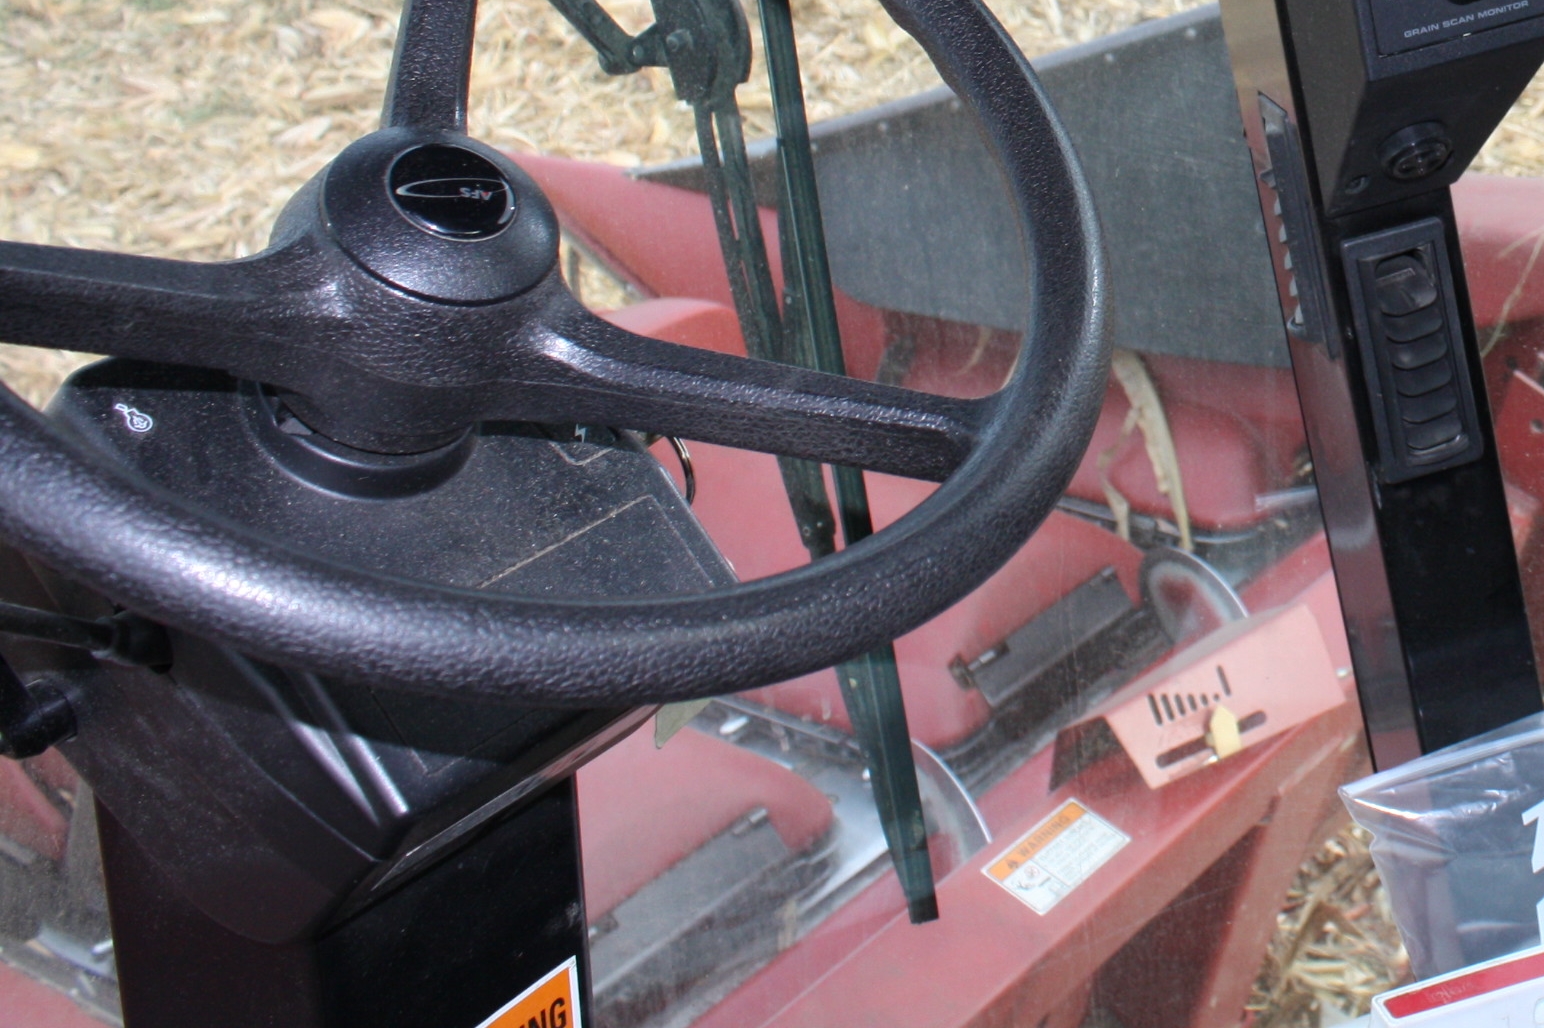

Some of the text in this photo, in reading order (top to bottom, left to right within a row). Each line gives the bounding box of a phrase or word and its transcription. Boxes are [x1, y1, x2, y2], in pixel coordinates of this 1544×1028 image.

[1403, 0, 1529, 39] GRAIN SCAN MONITOR
